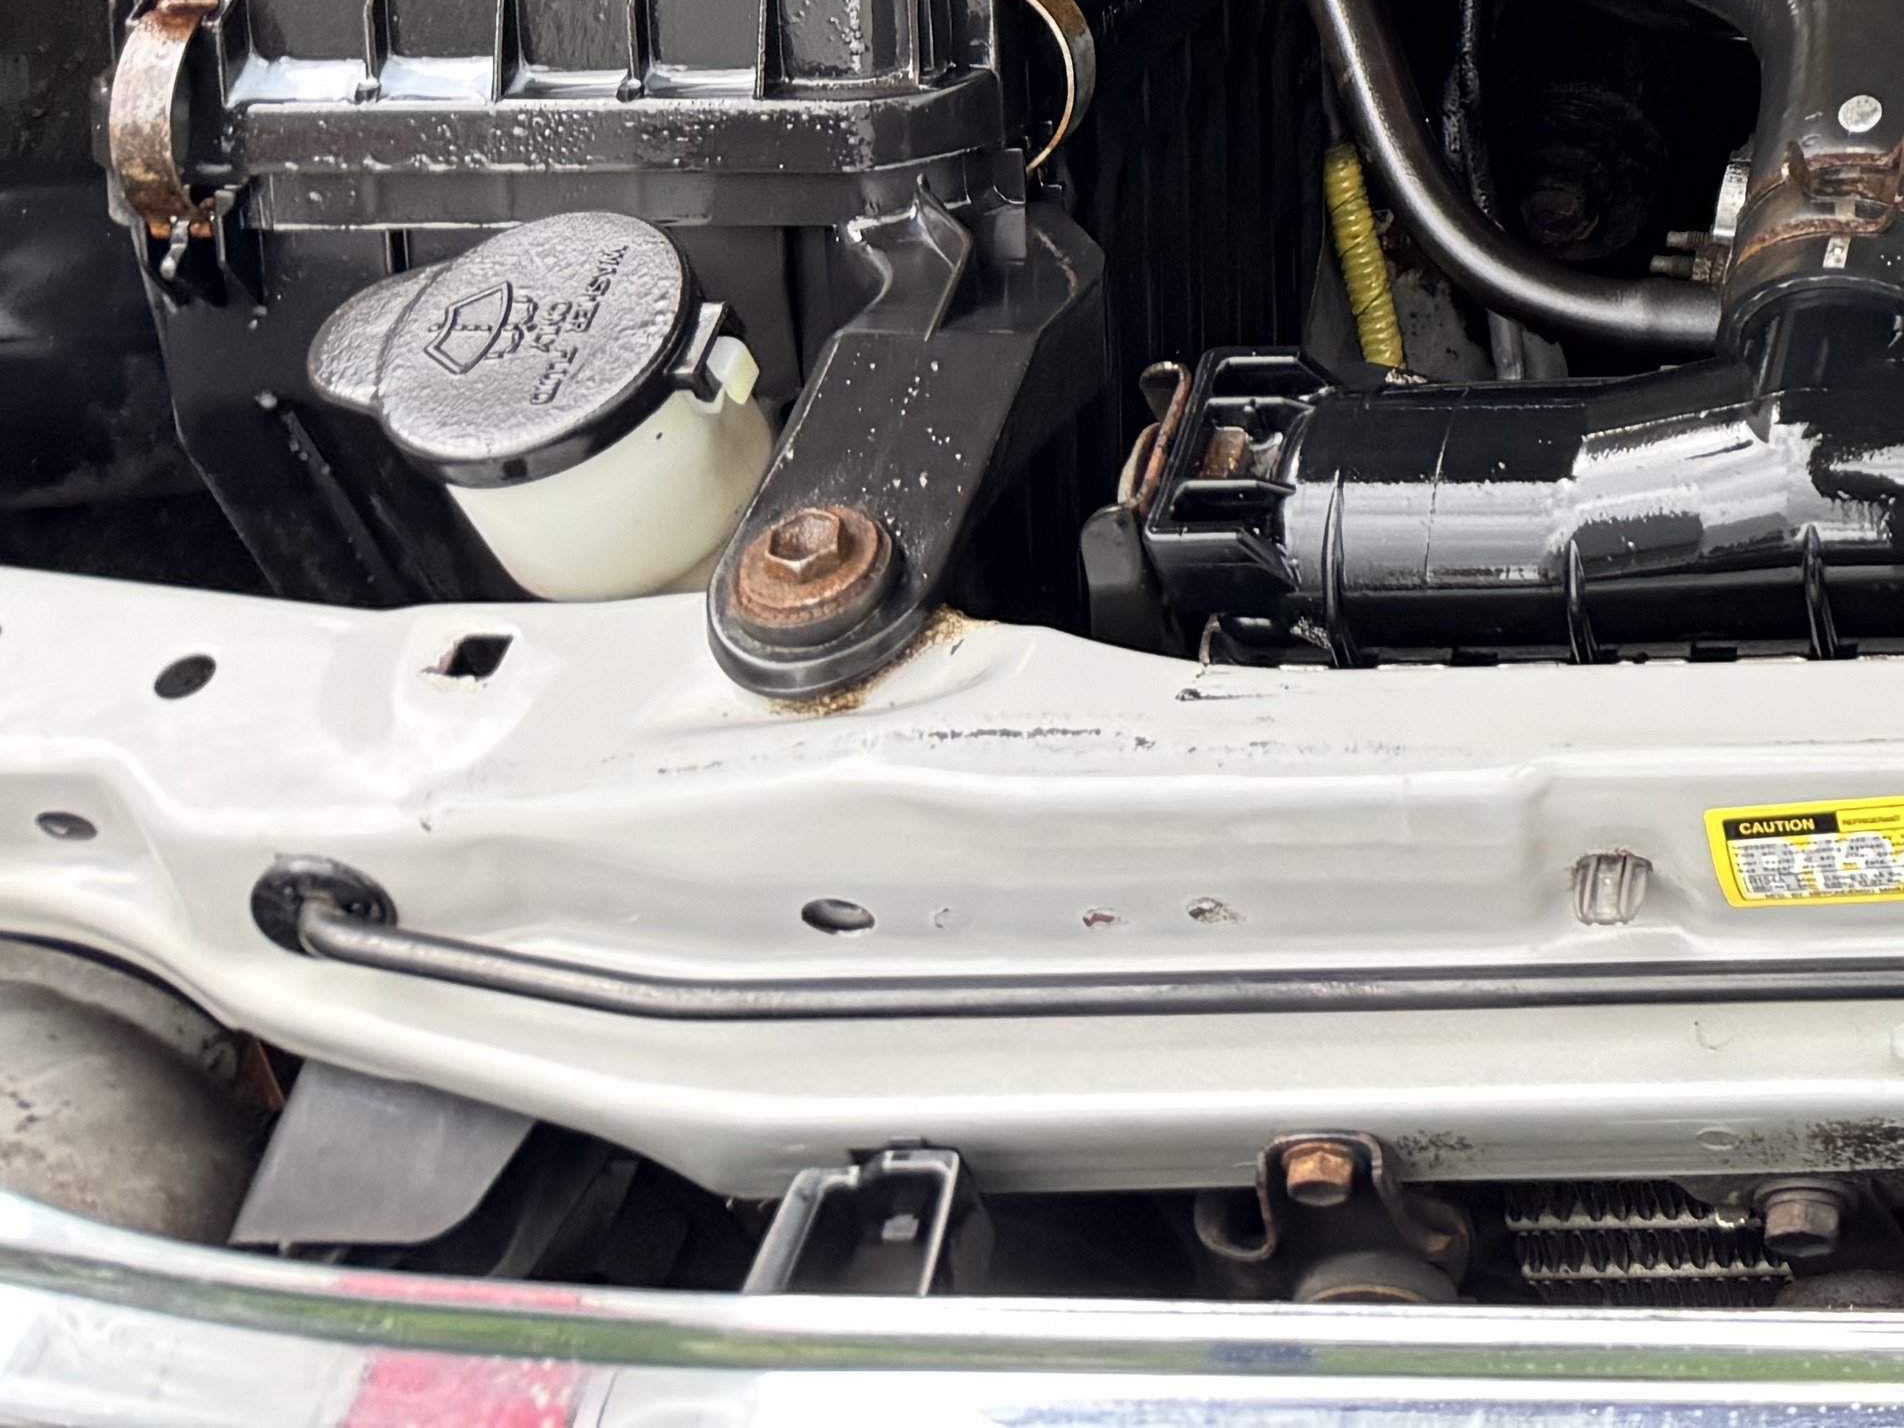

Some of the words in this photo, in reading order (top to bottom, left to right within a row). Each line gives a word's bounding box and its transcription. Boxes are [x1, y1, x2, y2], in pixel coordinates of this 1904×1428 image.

[565, 244, 629, 332] WASHER
[529, 345, 579, 406] FLUID
[1738, 817, 1816, 836] CAUTION
